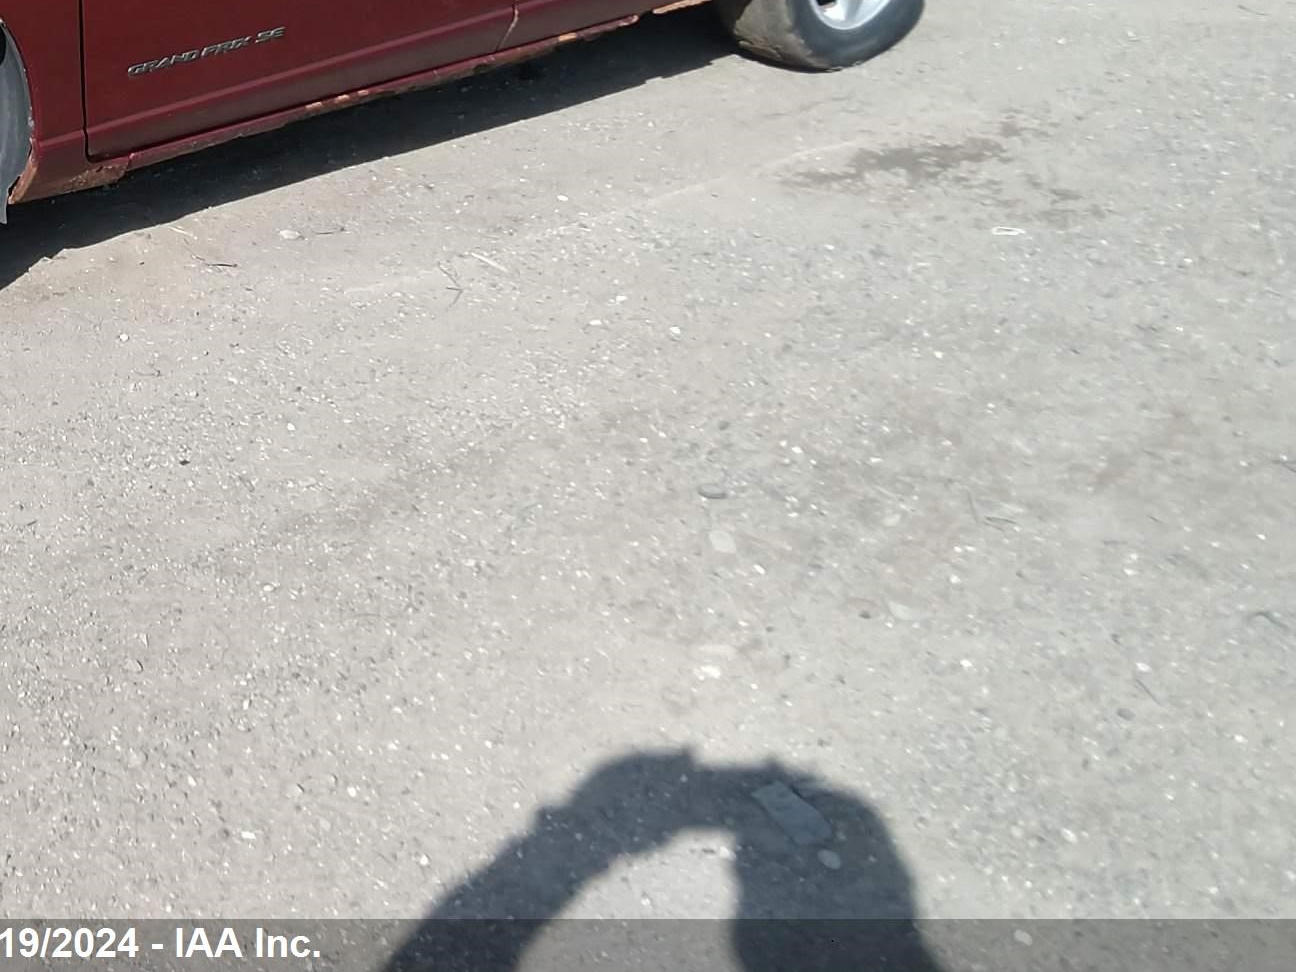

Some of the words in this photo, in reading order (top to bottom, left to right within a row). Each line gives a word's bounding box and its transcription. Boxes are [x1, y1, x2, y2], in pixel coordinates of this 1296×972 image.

[127, 49, 201, 77] GRAND
[201, 35, 253, 59] PRIX
[255, 25, 286, 44] SE
